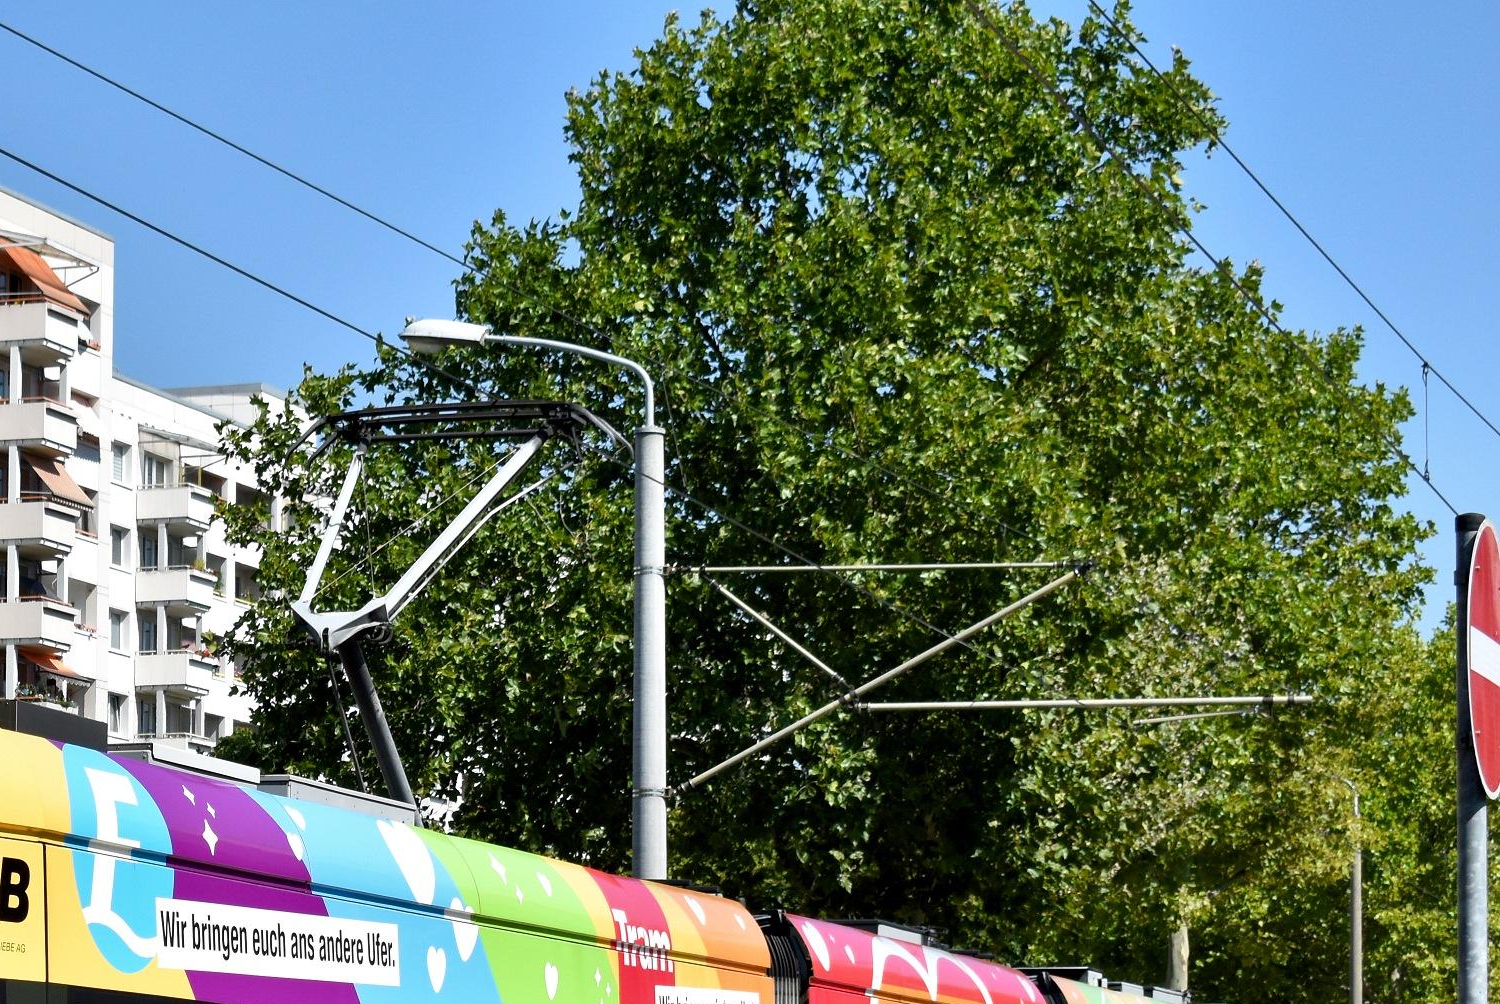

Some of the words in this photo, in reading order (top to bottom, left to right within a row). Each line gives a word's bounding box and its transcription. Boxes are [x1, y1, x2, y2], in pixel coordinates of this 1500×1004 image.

[16, 943, 26, 953] AG
[160, 910, 187, 948] Wir
[192, 913, 248, 960] bringen
[252, 923, 286, 957] euch
[291, 931, 315, 960] ans
[319, 929, 364, 964] andere
[367, 932, 395, 967] Ufer.
[611, 908, 674, 973] Tram
